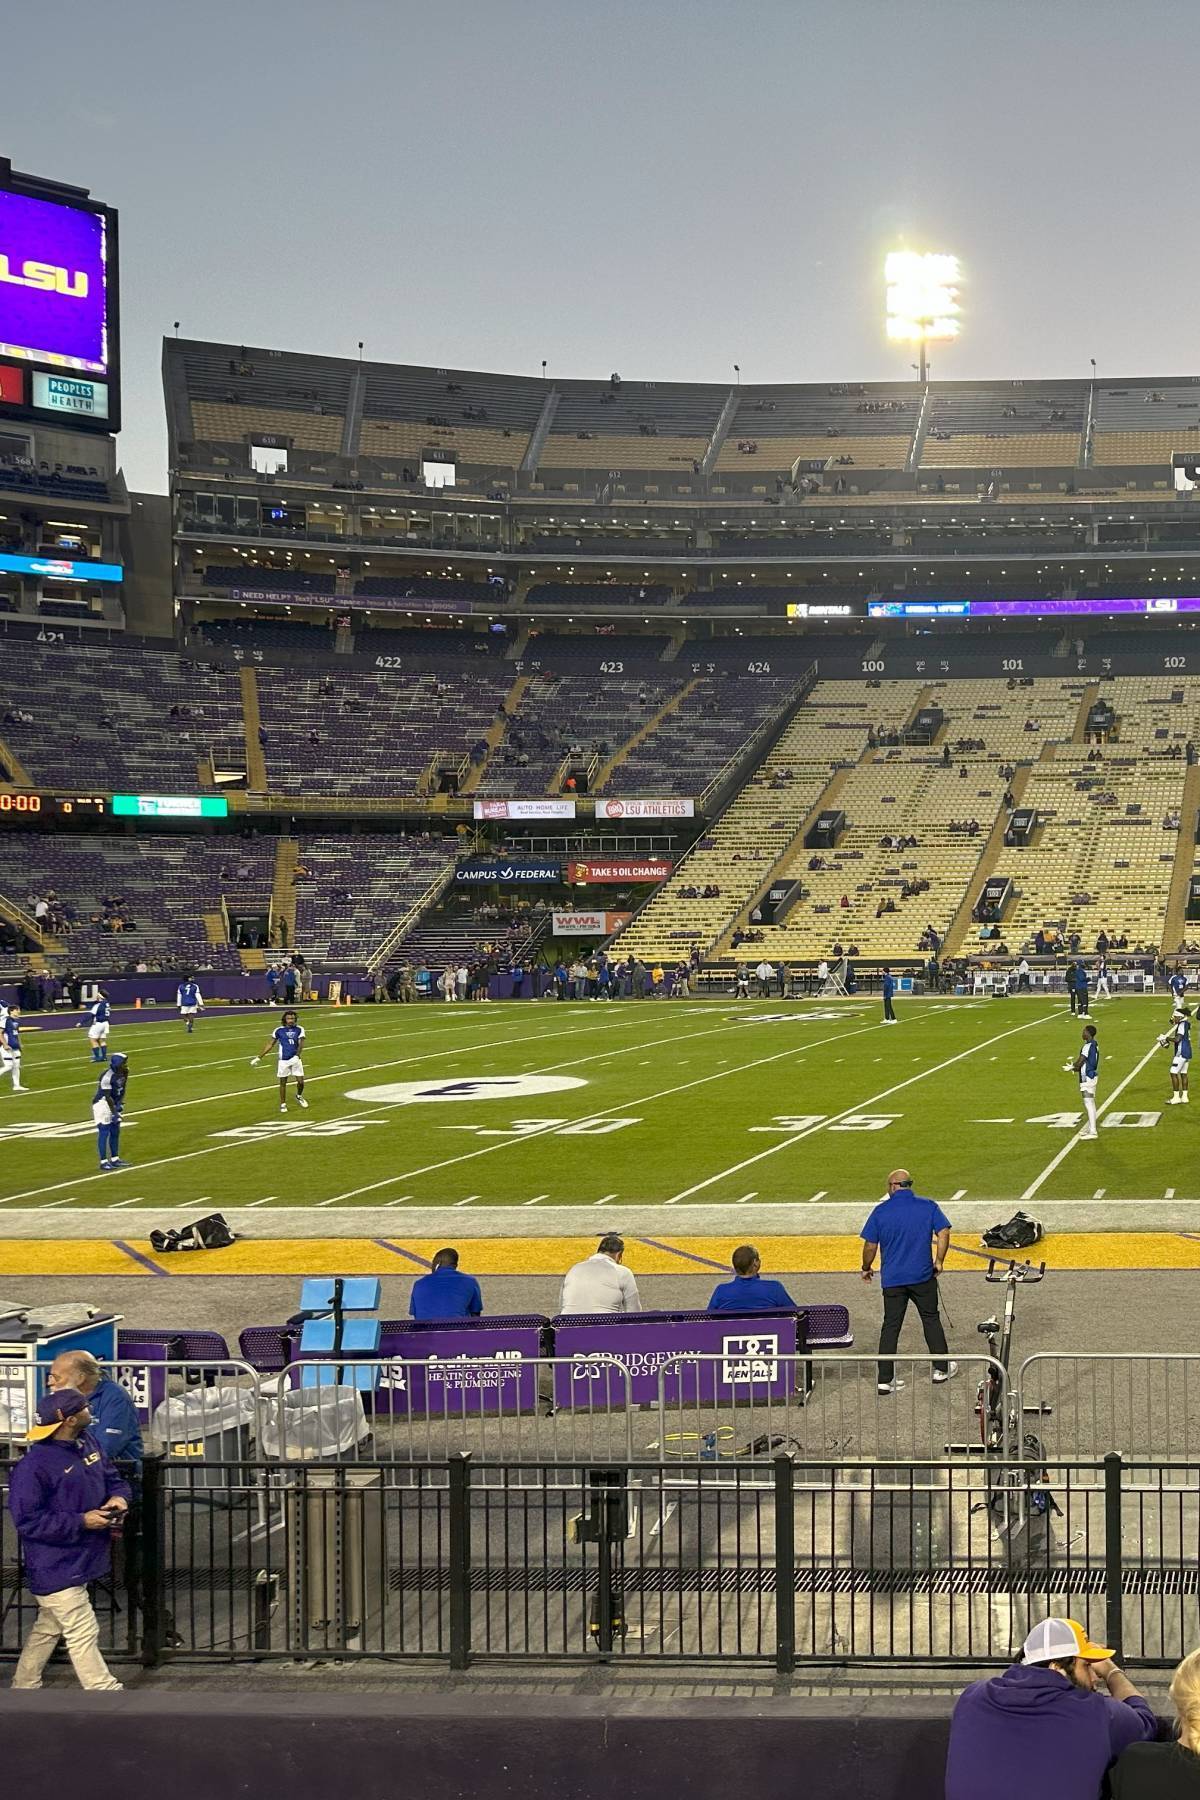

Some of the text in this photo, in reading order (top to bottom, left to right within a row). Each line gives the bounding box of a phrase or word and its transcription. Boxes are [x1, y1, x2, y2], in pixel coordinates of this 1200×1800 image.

[0, 254, 89, 298] LSU
[51, 380, 93, 396] PEOPLES
[51, 394, 92, 410] HEALTH
[242, 591, 265, 599] NEED
[265, 593, 290, 601] HELP?
[1146, 599, 1178, 611] LSU
[36, 631, 65, 642] 421
[375, 656, 401, 669] 422
[600, 661, 624, 673] 423
[747, 661, 771, 673] 424
[861, 660, 885, 672] 100
[1002, 659, 1024, 671] 101
[1164, 656, 1186, 668] 102
[63, 802, 72, 813] 0
[625, 804, 686, 815] LSU ATHLETICS
[456, 869, 557, 880] CAMPUS FEDERAL
[591, 867, 668, 877] TAKE 5 OIL CHANGE
[556, 916, 600, 925] WWL
[747, 1113, 905, 1132] 35
[1023, 1110, 1162, 1129] 40
[206, 1119, 390, 1138] 25
[476, 1117, 644, 1136] 30
[727, 1369, 773, 1379] RENTALS
[446, 1381, 453, 1389] &
